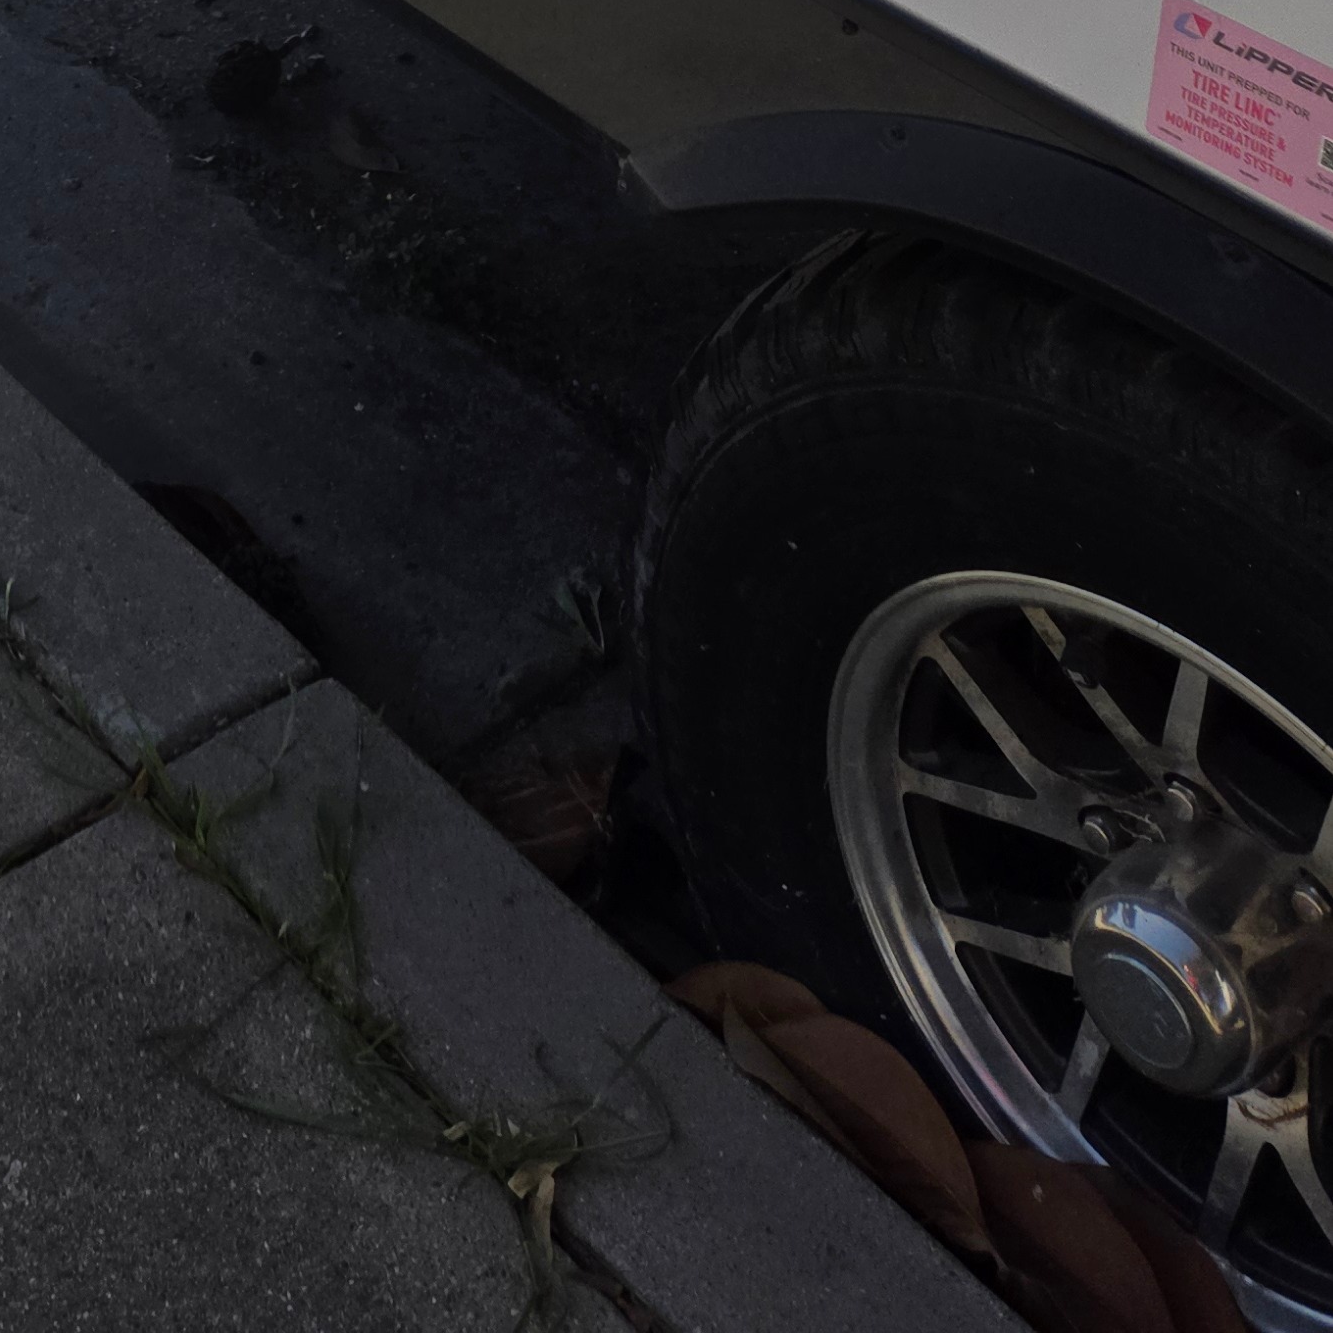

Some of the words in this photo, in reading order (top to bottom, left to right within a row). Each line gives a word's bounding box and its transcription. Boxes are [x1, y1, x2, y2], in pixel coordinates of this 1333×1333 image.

[1170, 41, 1196, 63] THIS
[1198, 56, 1226, 77] UNIT
[1227, 70, 1284, 107] PREPPED
[1285, 99, 1311, 122] FOR
[1192, 69, 1231, 105] TIRE
[1181, 85, 1208, 110] TIRE
[1209, 101, 1275, 146] PRESSURE
[1187, 104, 1275, 163] TEMPERATURE
[1165, 109, 1242, 160] MONITORING
[1243, 153, 1294, 188] SYSTEM
